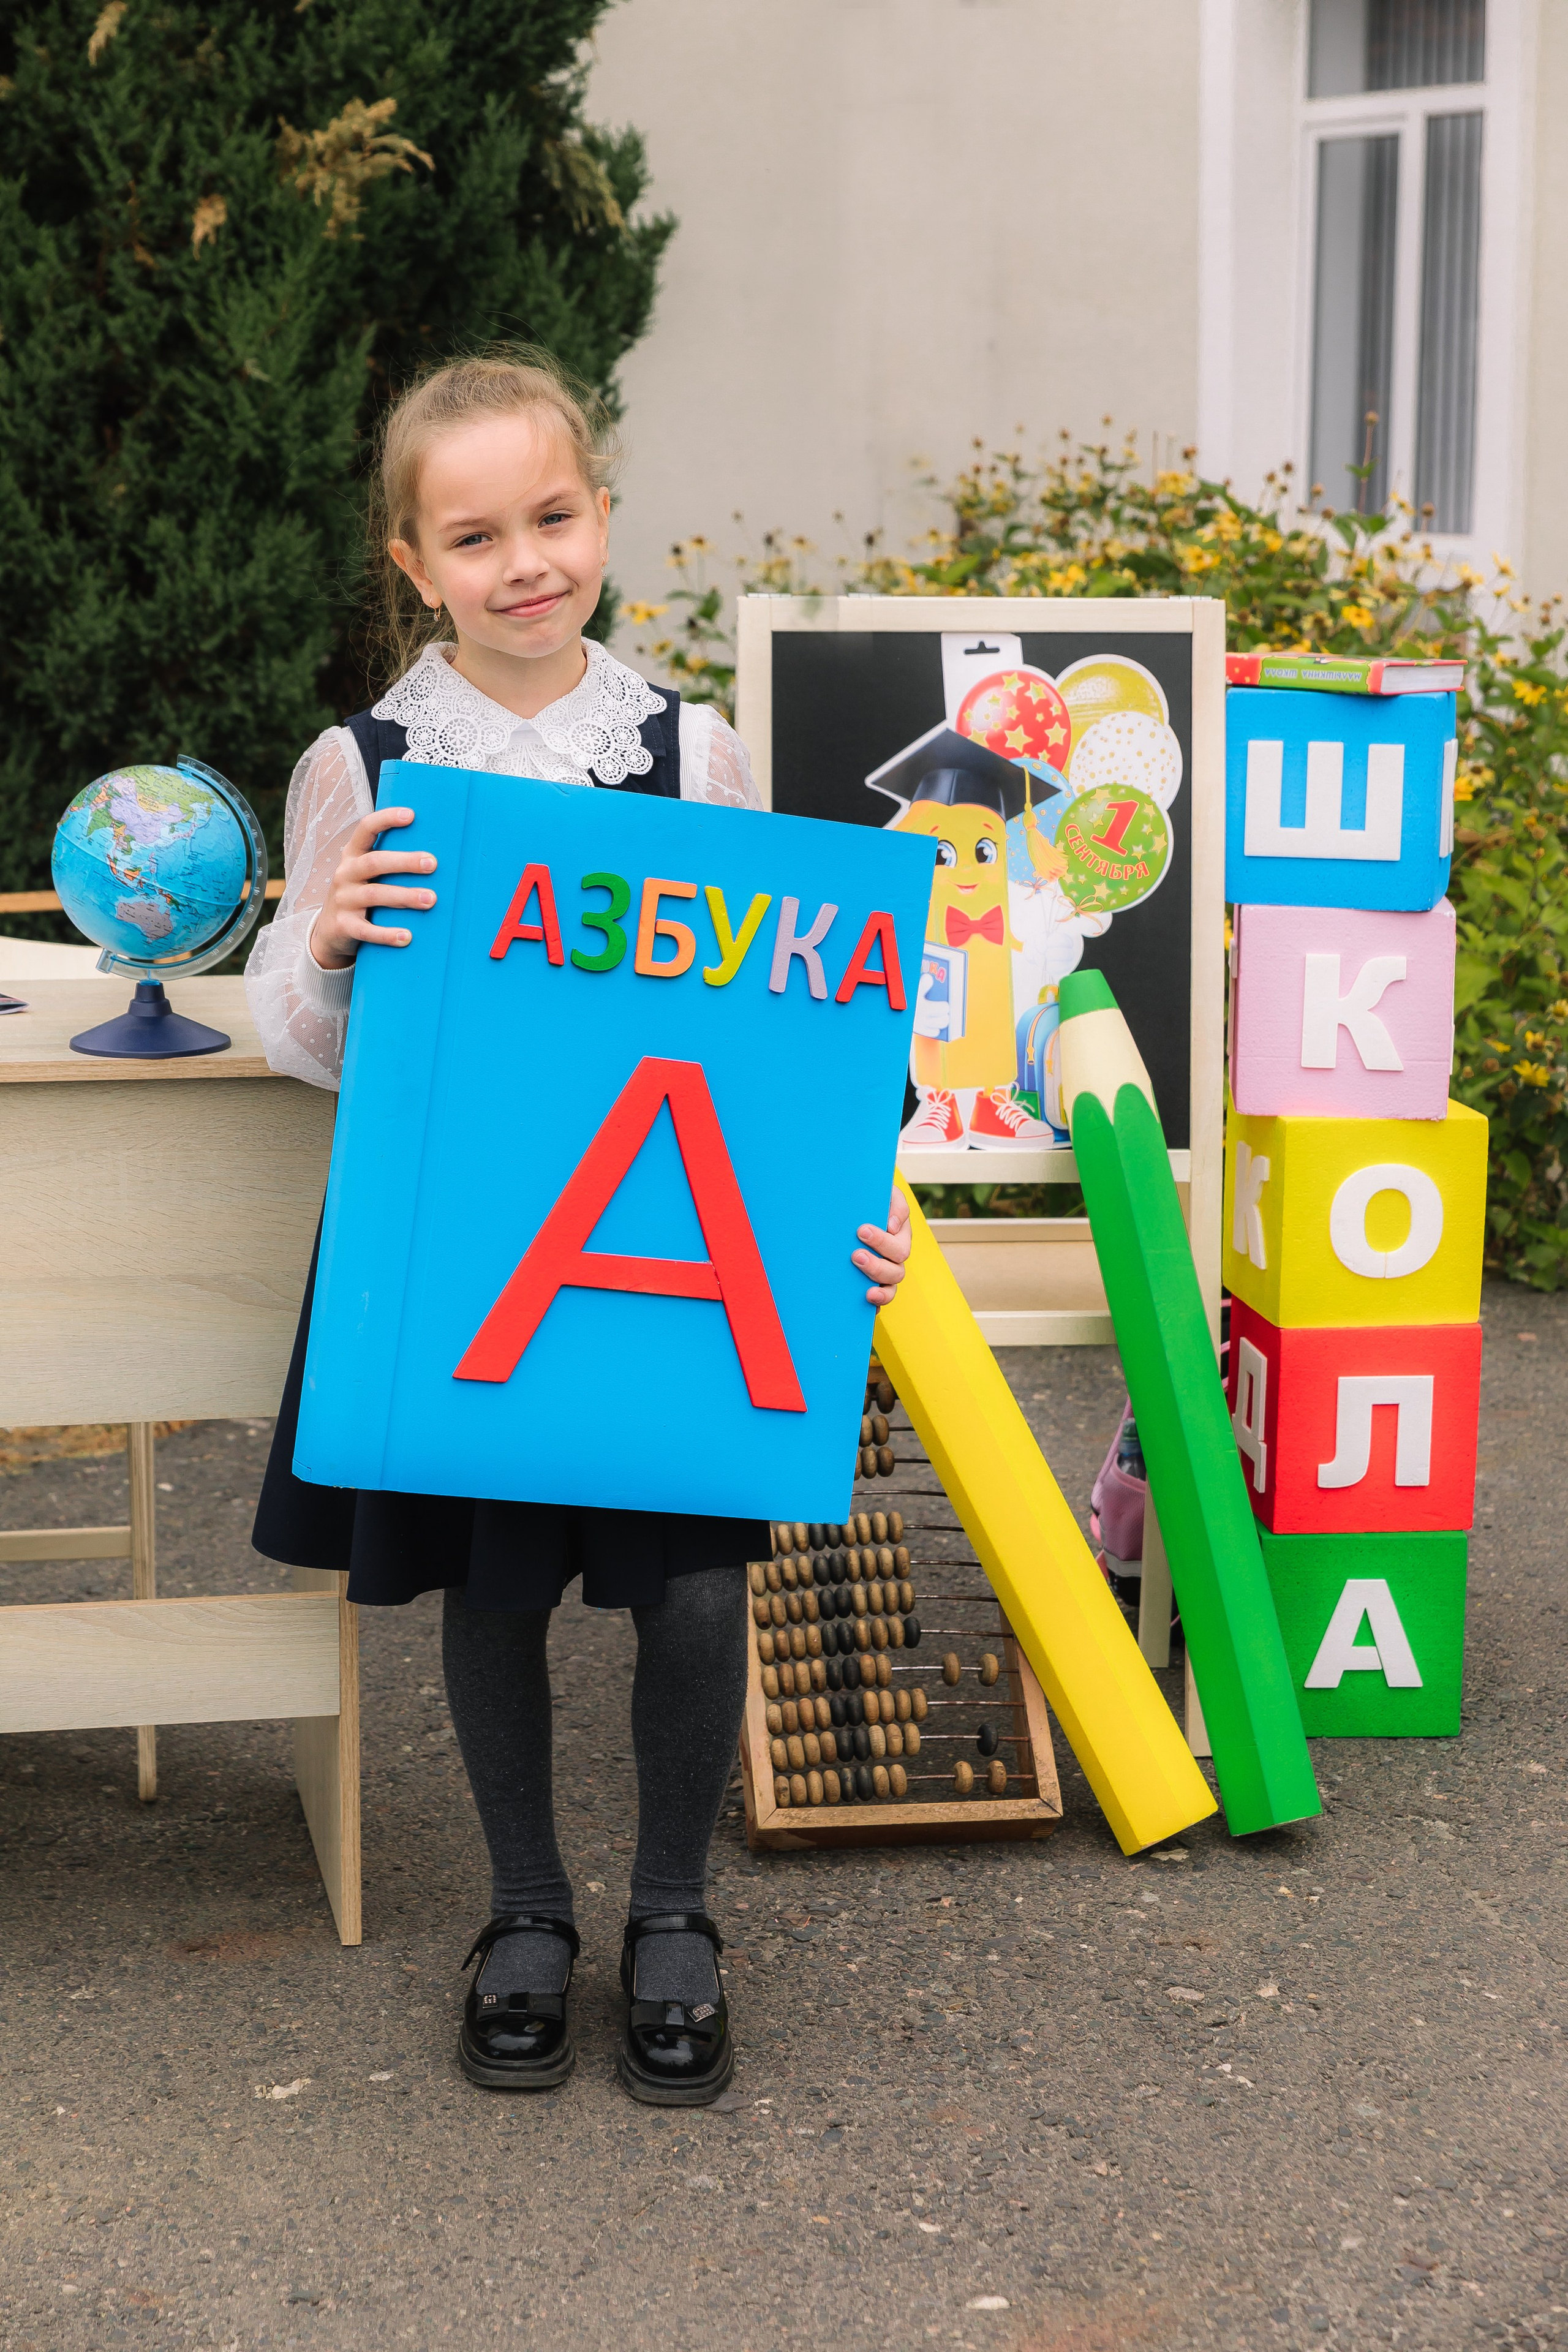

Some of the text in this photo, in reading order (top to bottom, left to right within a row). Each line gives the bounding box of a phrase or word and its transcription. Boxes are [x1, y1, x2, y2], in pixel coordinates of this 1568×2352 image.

[1265, 668, 1362, 682] МАЛЫШКИНА ШКОЛА
[1065, 823, 1150, 880] СЕНТЯБРЯ
[1090, 799, 1140, 857] 1
[1244, 740, 1405, 861] Ш
[489, 862, 907, 1011] АЗБУКА
[1301, 953, 1406, 1071] К
[452, 1055, 807, 1412] А
[1233, 1140, 1270, 1270] К
[1329, 1164, 1444, 1278] О
[1317, 1375, 1434, 1488] Л
[1304, 1579, 1423, 1689] А
